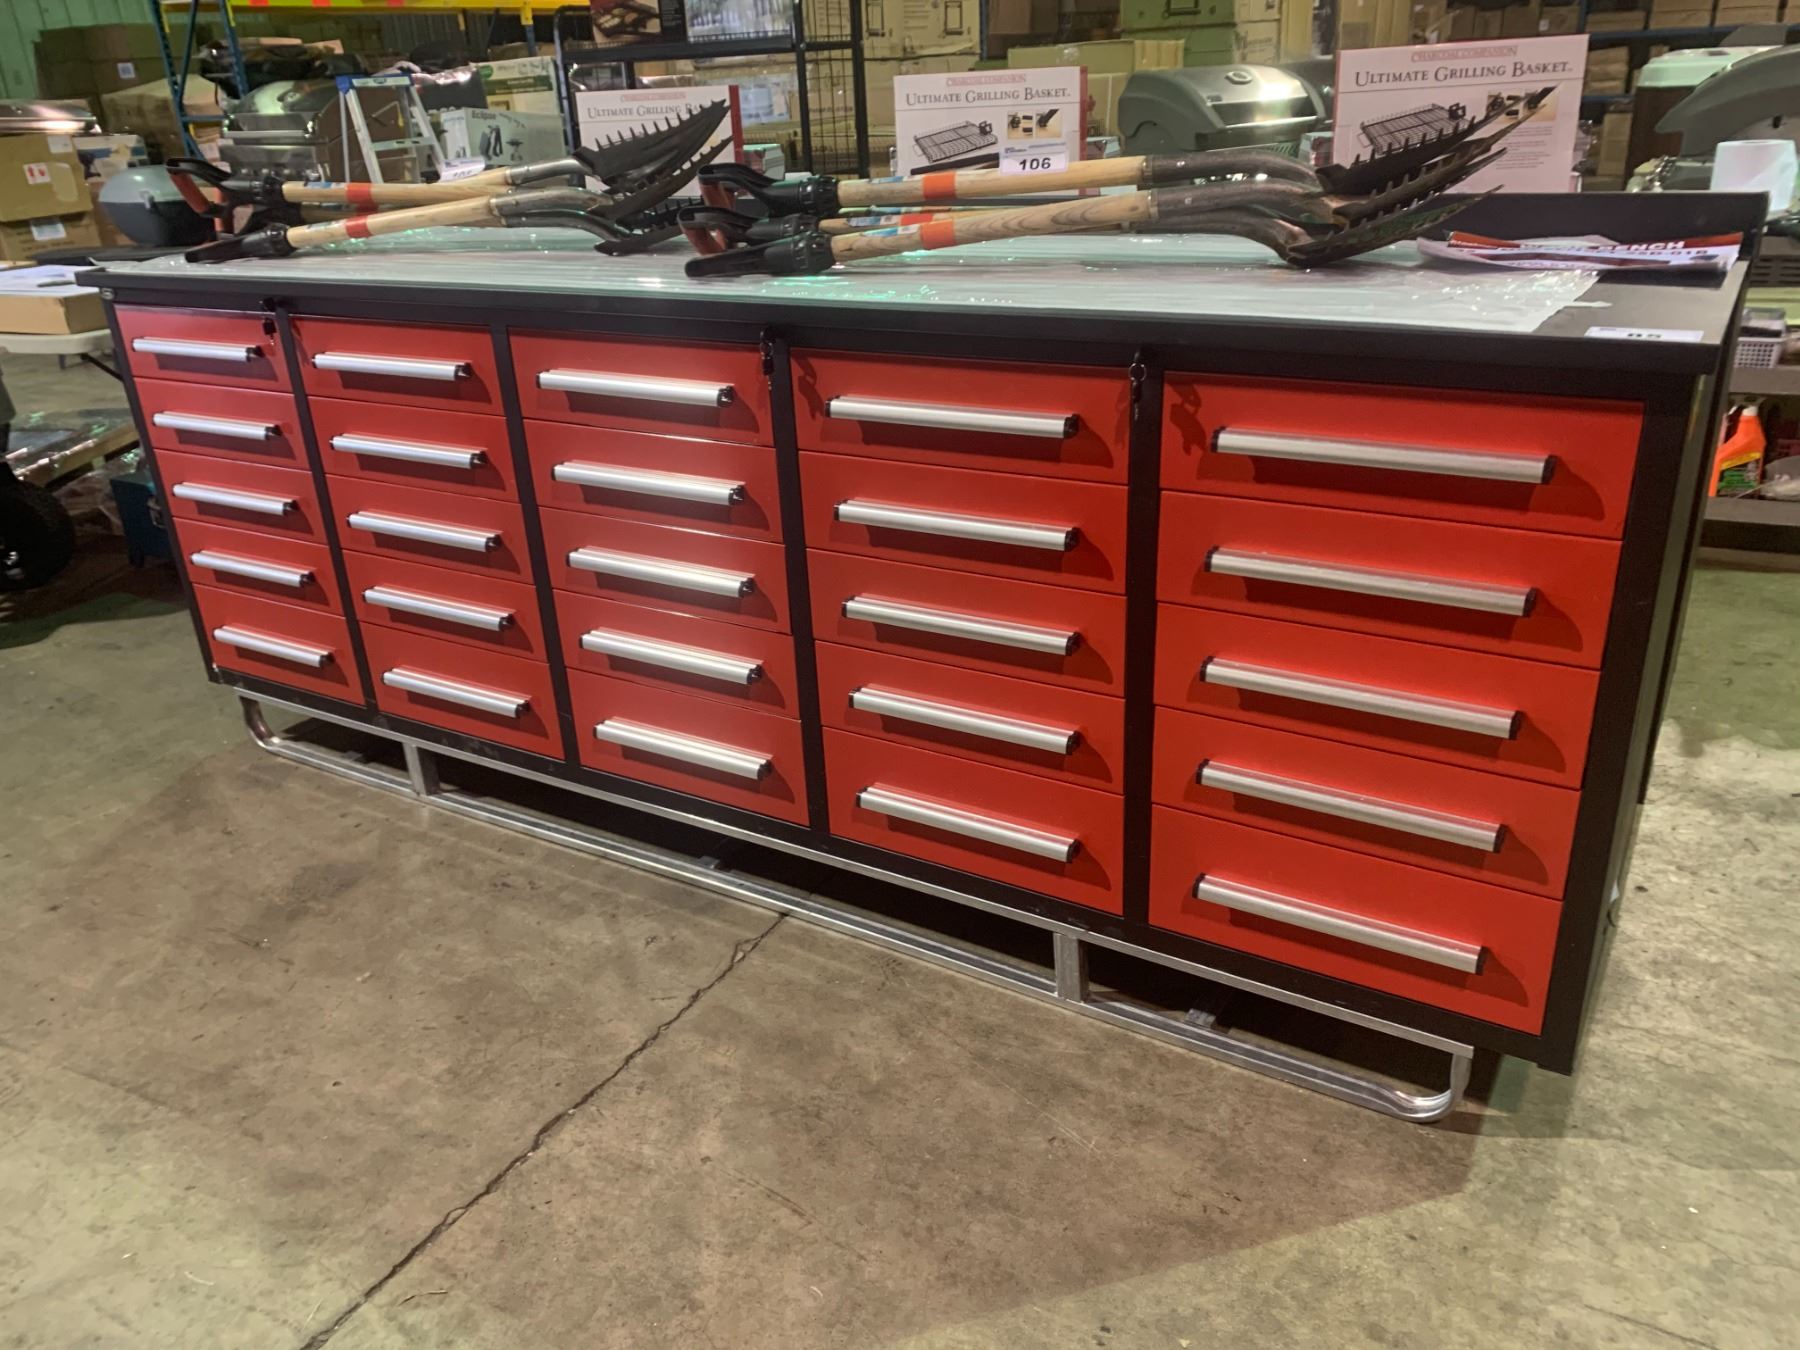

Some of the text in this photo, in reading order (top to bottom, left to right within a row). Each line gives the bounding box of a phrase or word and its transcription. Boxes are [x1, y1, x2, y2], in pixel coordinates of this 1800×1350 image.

[1355, 68, 1429, 87] ULTIMATE
[1434, 64, 1506, 82] GRILLING
[906, 92, 962, 106] ULTIMATE
[965, 89, 1020, 104] GRILLING
[587, 106, 633, 119] ULTIMATE
[636, 104, 682, 117] GRILLING
[1019, 157, 1052, 171] 106
